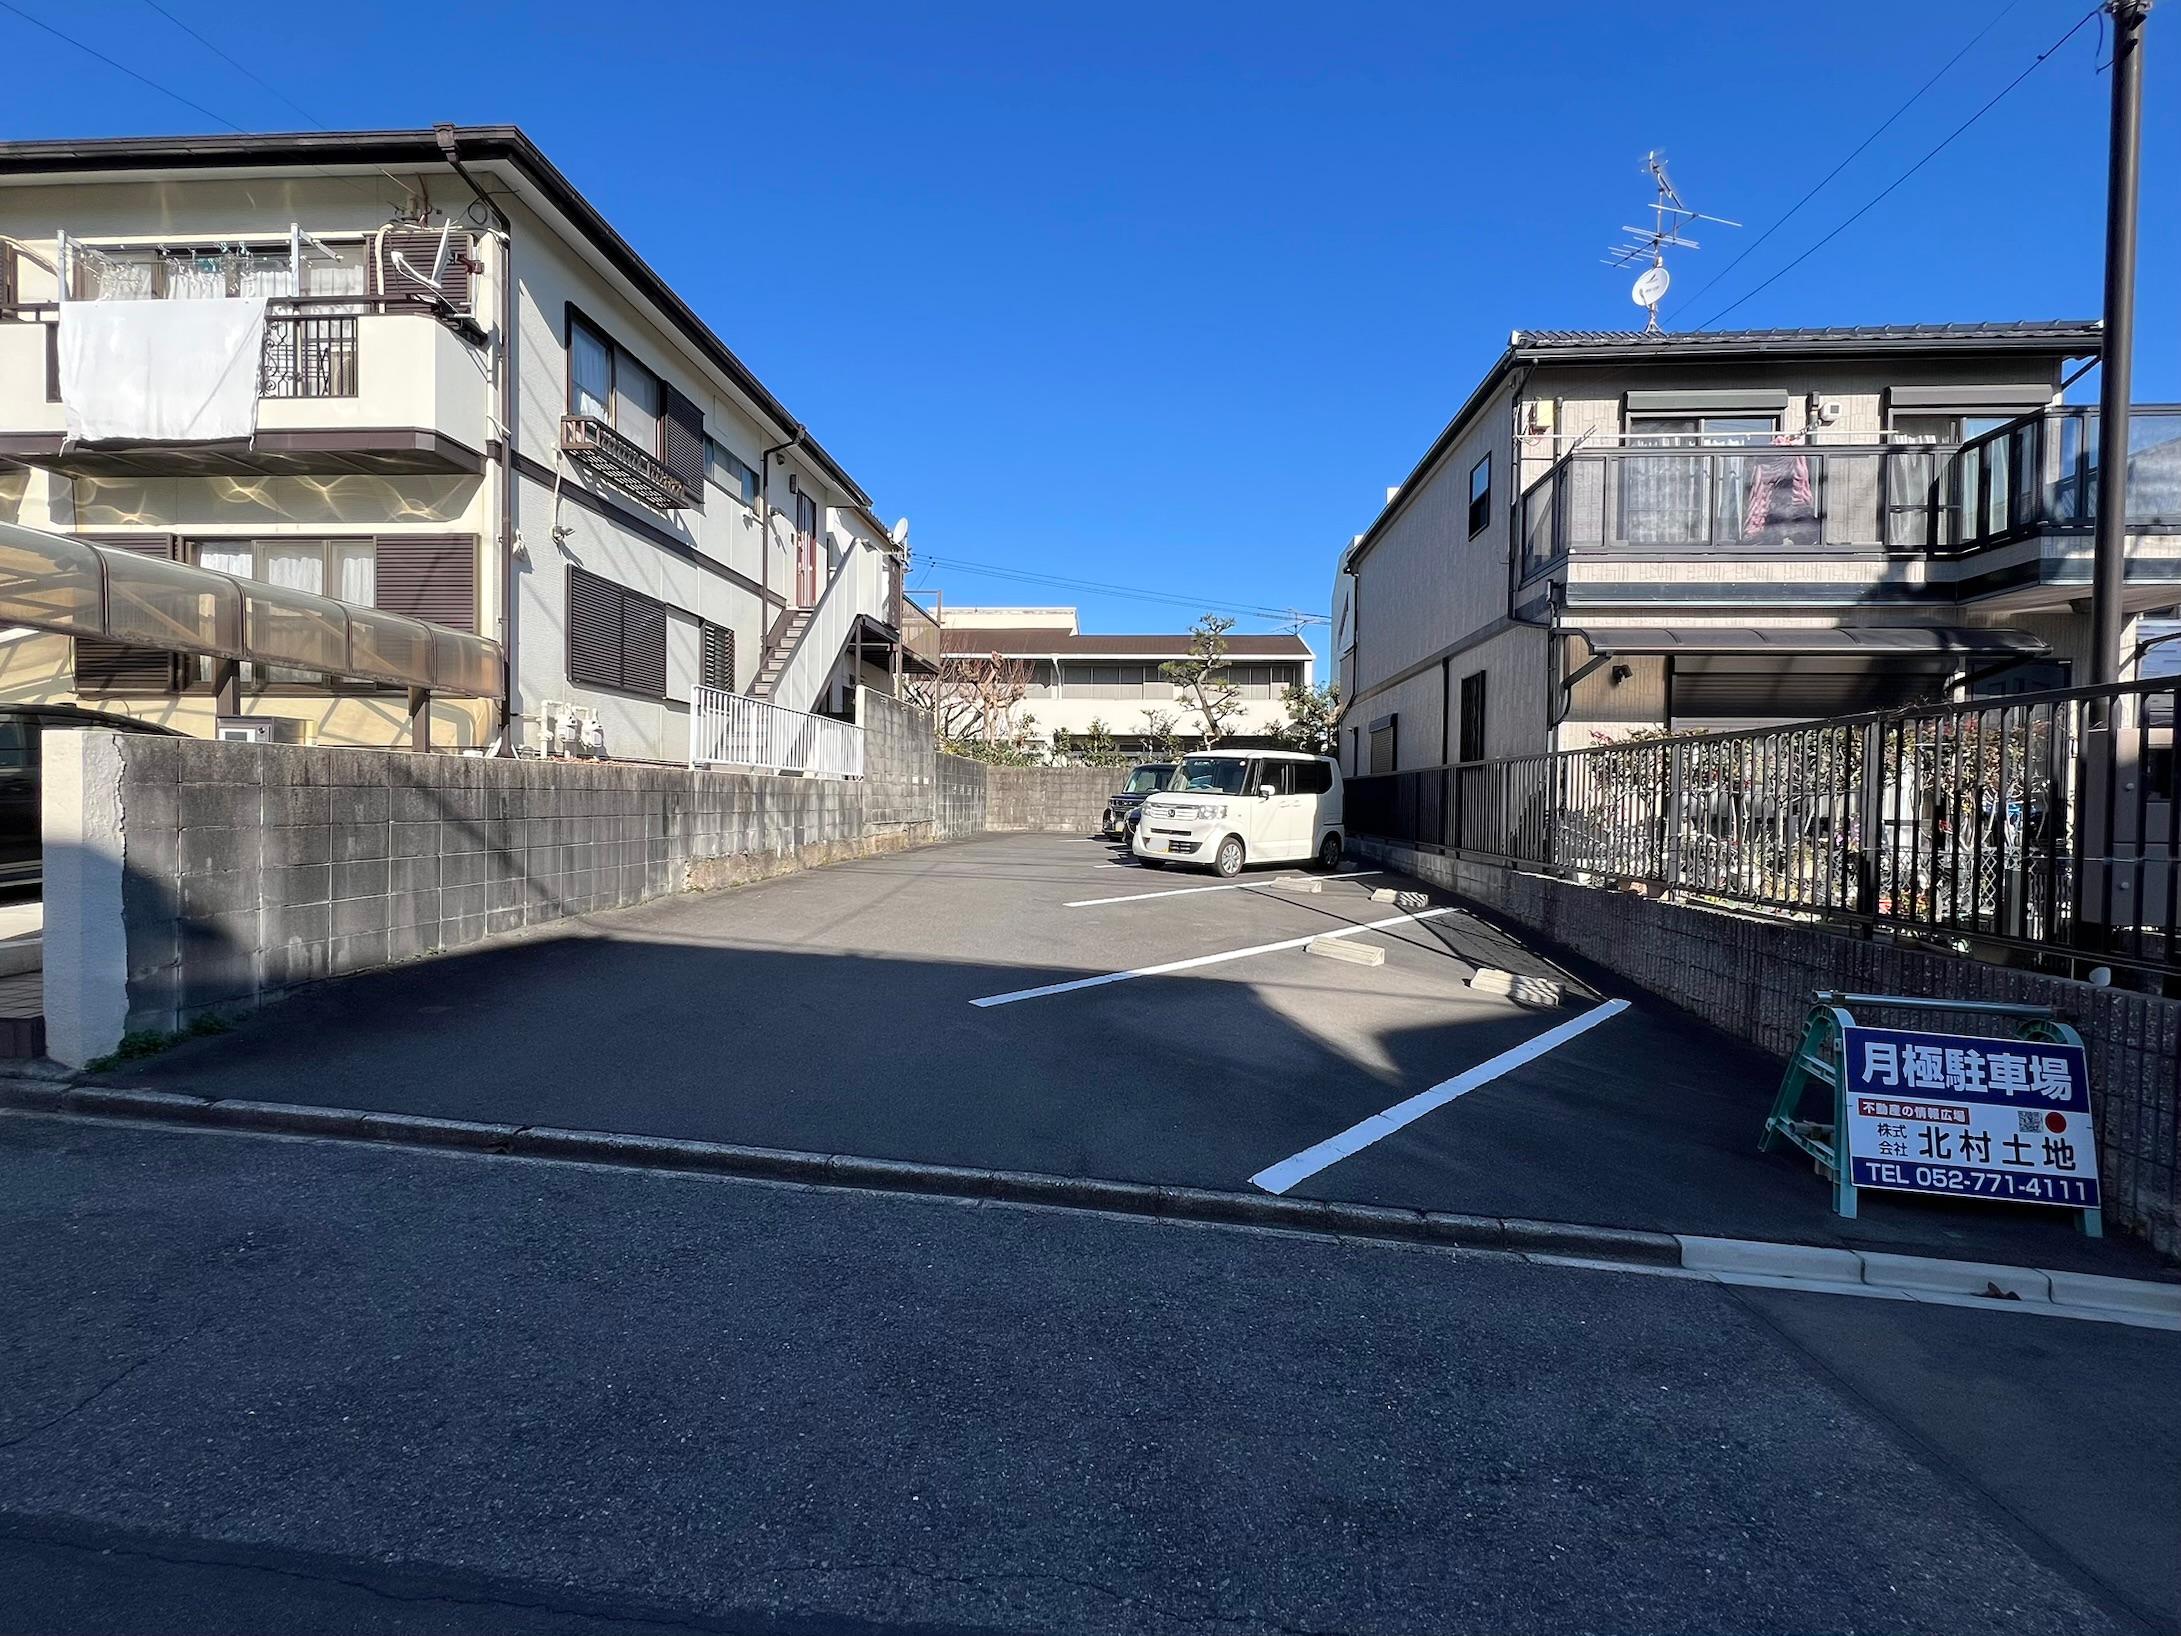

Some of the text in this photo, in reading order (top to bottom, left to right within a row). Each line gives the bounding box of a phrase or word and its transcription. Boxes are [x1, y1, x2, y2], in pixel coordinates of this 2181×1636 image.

[1862, 1042, 2072, 1101] 月極駐車場
[1863, 1101, 1966, 1123] 不動産の情報広場
[1877, 1123, 1908, 1139] 株式
[1879, 1141, 1909, 1157] 会社
[1918, 1126, 2076, 1171] 北村土地
[1866, 1162, 2086, 1201] TEL 052-771-4111
